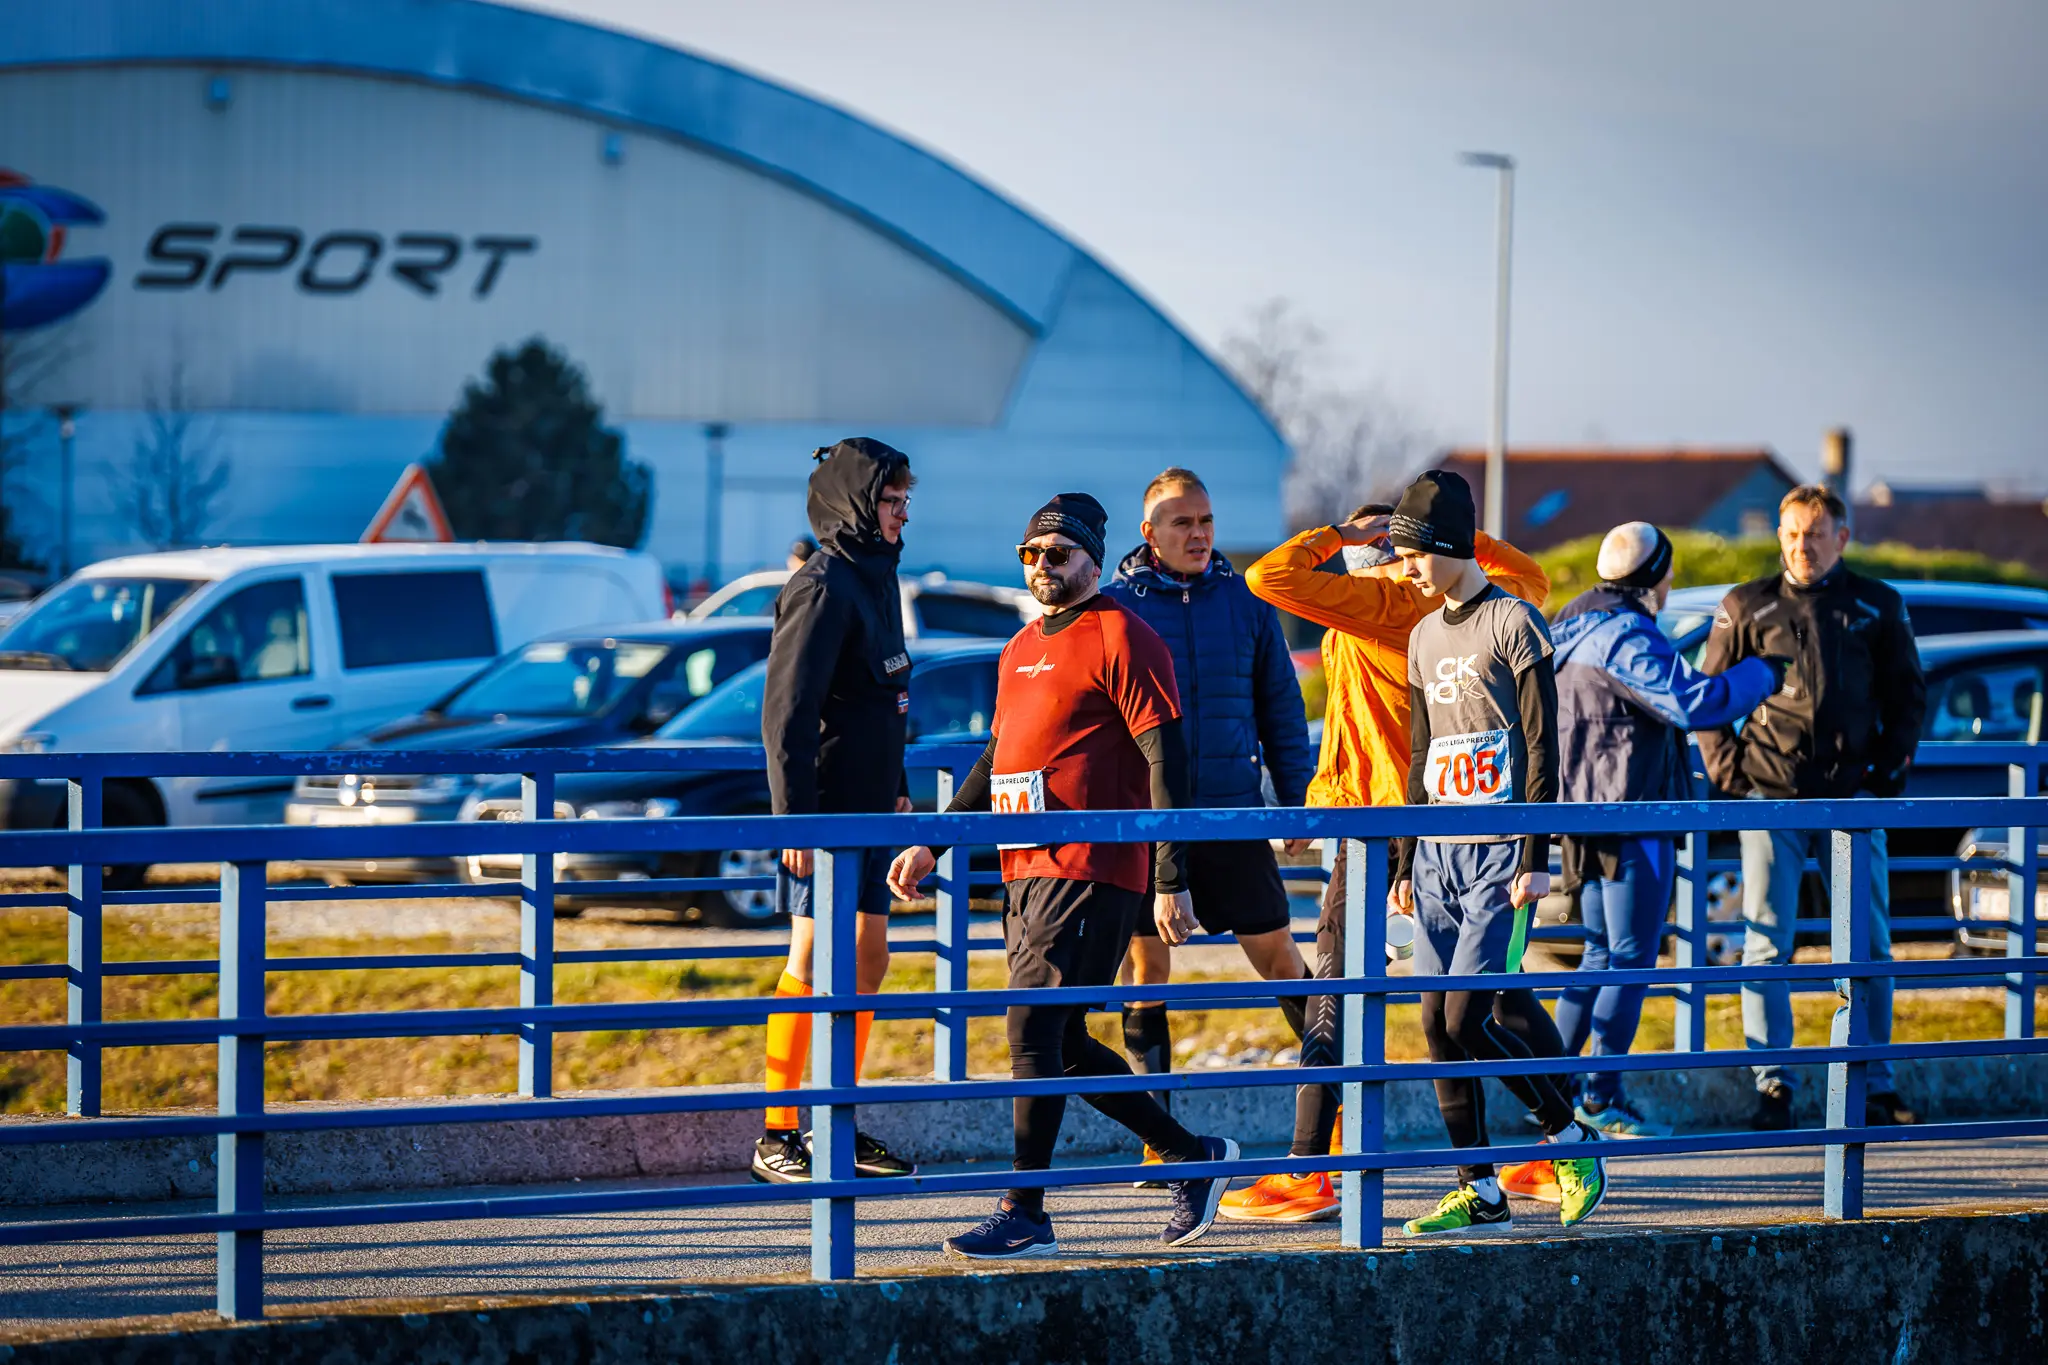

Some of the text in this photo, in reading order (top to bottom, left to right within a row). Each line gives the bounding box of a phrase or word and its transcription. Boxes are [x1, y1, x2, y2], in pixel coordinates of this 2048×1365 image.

[134, 222, 537, 299] SPORT
[1436, 654, 1480, 680] CK
[1466, 735, 1496, 744] PRELOG
[1006, 776, 1029, 785] PRELOG
[1436, 750, 1500, 796] 705
